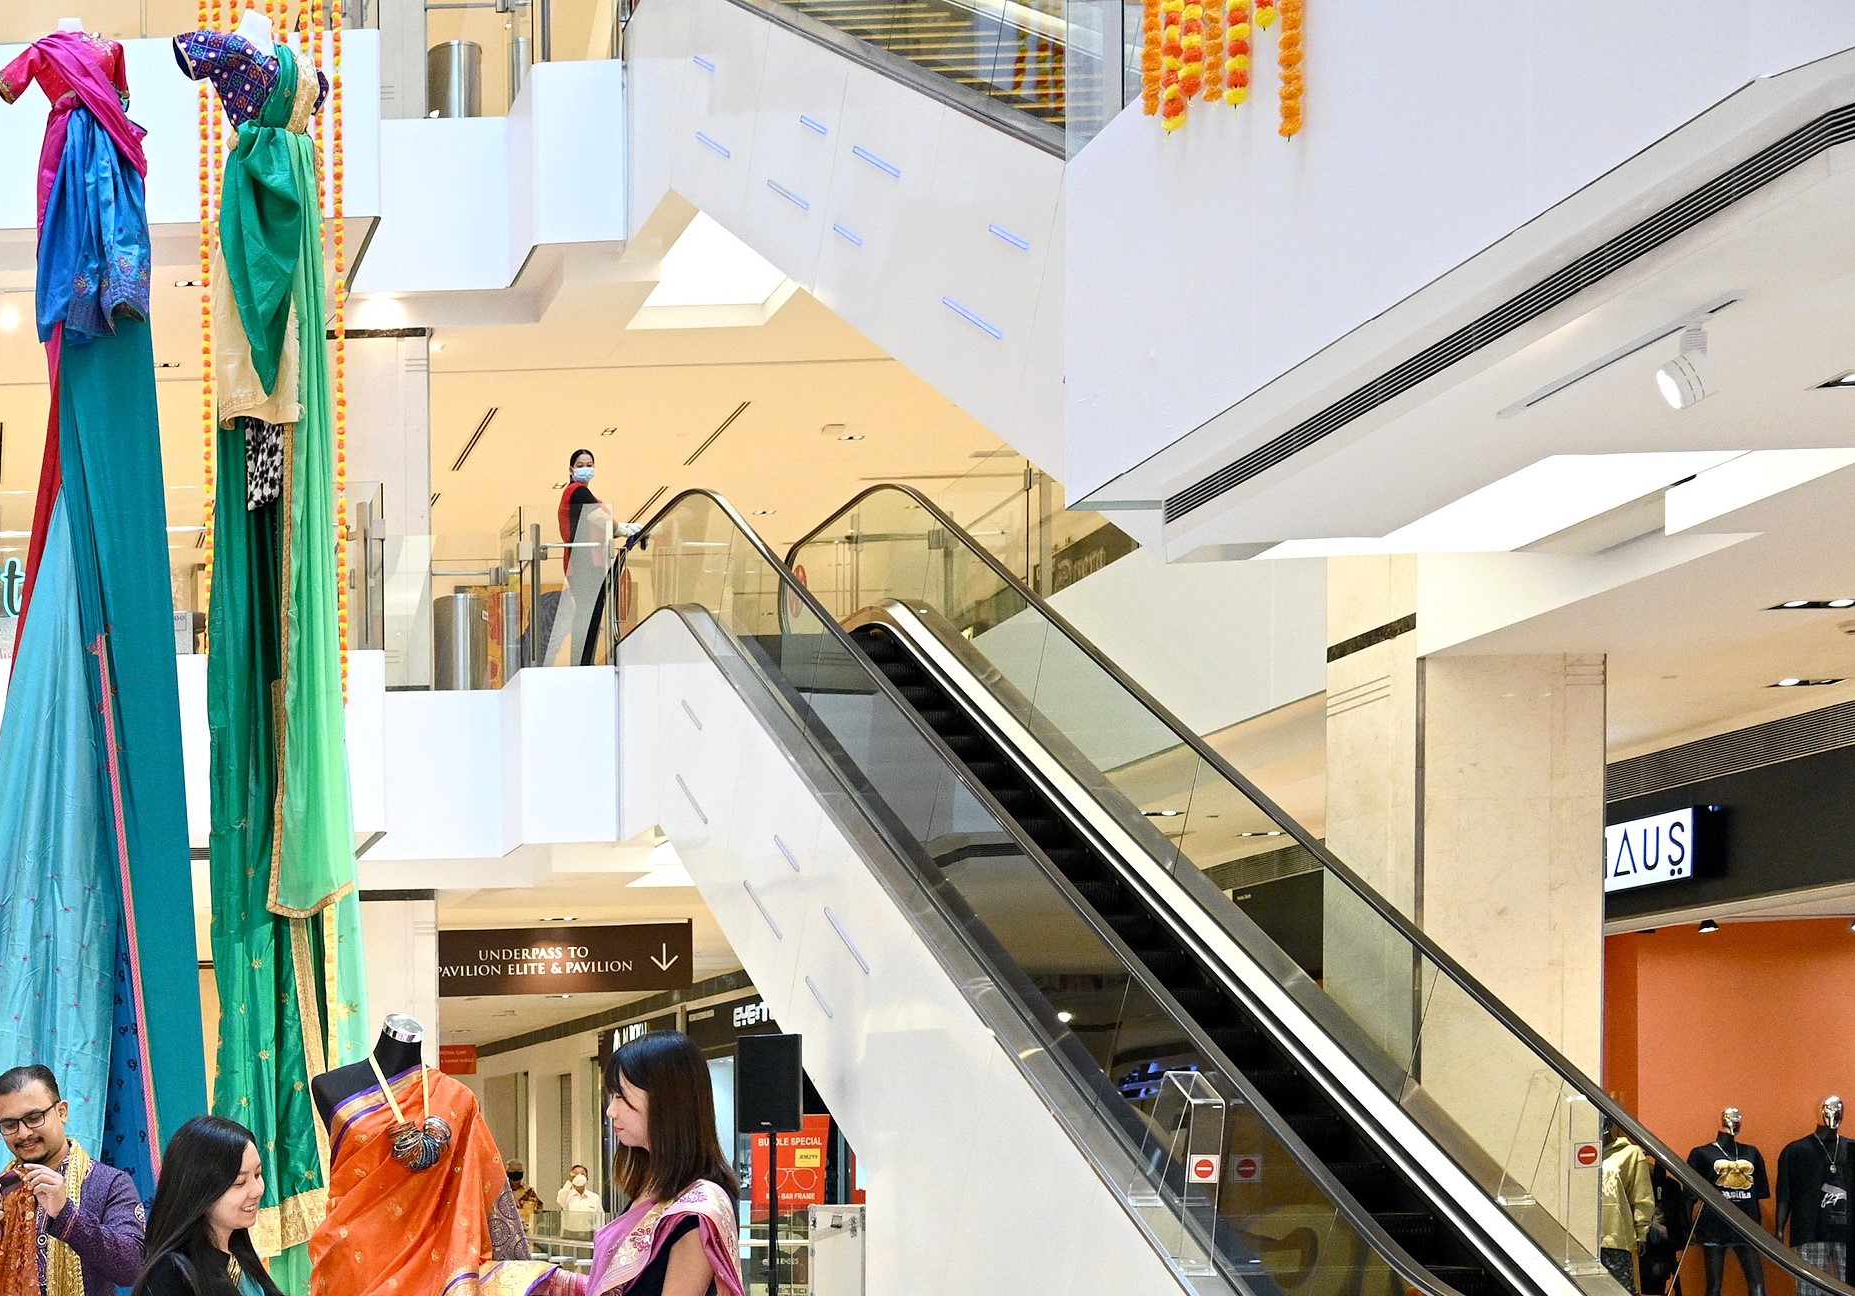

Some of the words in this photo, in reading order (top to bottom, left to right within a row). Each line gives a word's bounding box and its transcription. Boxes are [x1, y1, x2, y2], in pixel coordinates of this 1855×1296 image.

[1603, 821, 1687, 878] AUS
[478, 947, 563, 961] UNDERPASS
[567, 946, 589, 959] TO
[508, 962, 546, 975] ELITE
[550, 961, 564, 975] &
[565, 960, 633, 974] PAVILION
[758, 1137, 788, 1146] BUDLE
[791, 1136, 823, 1146] SPECIAL
